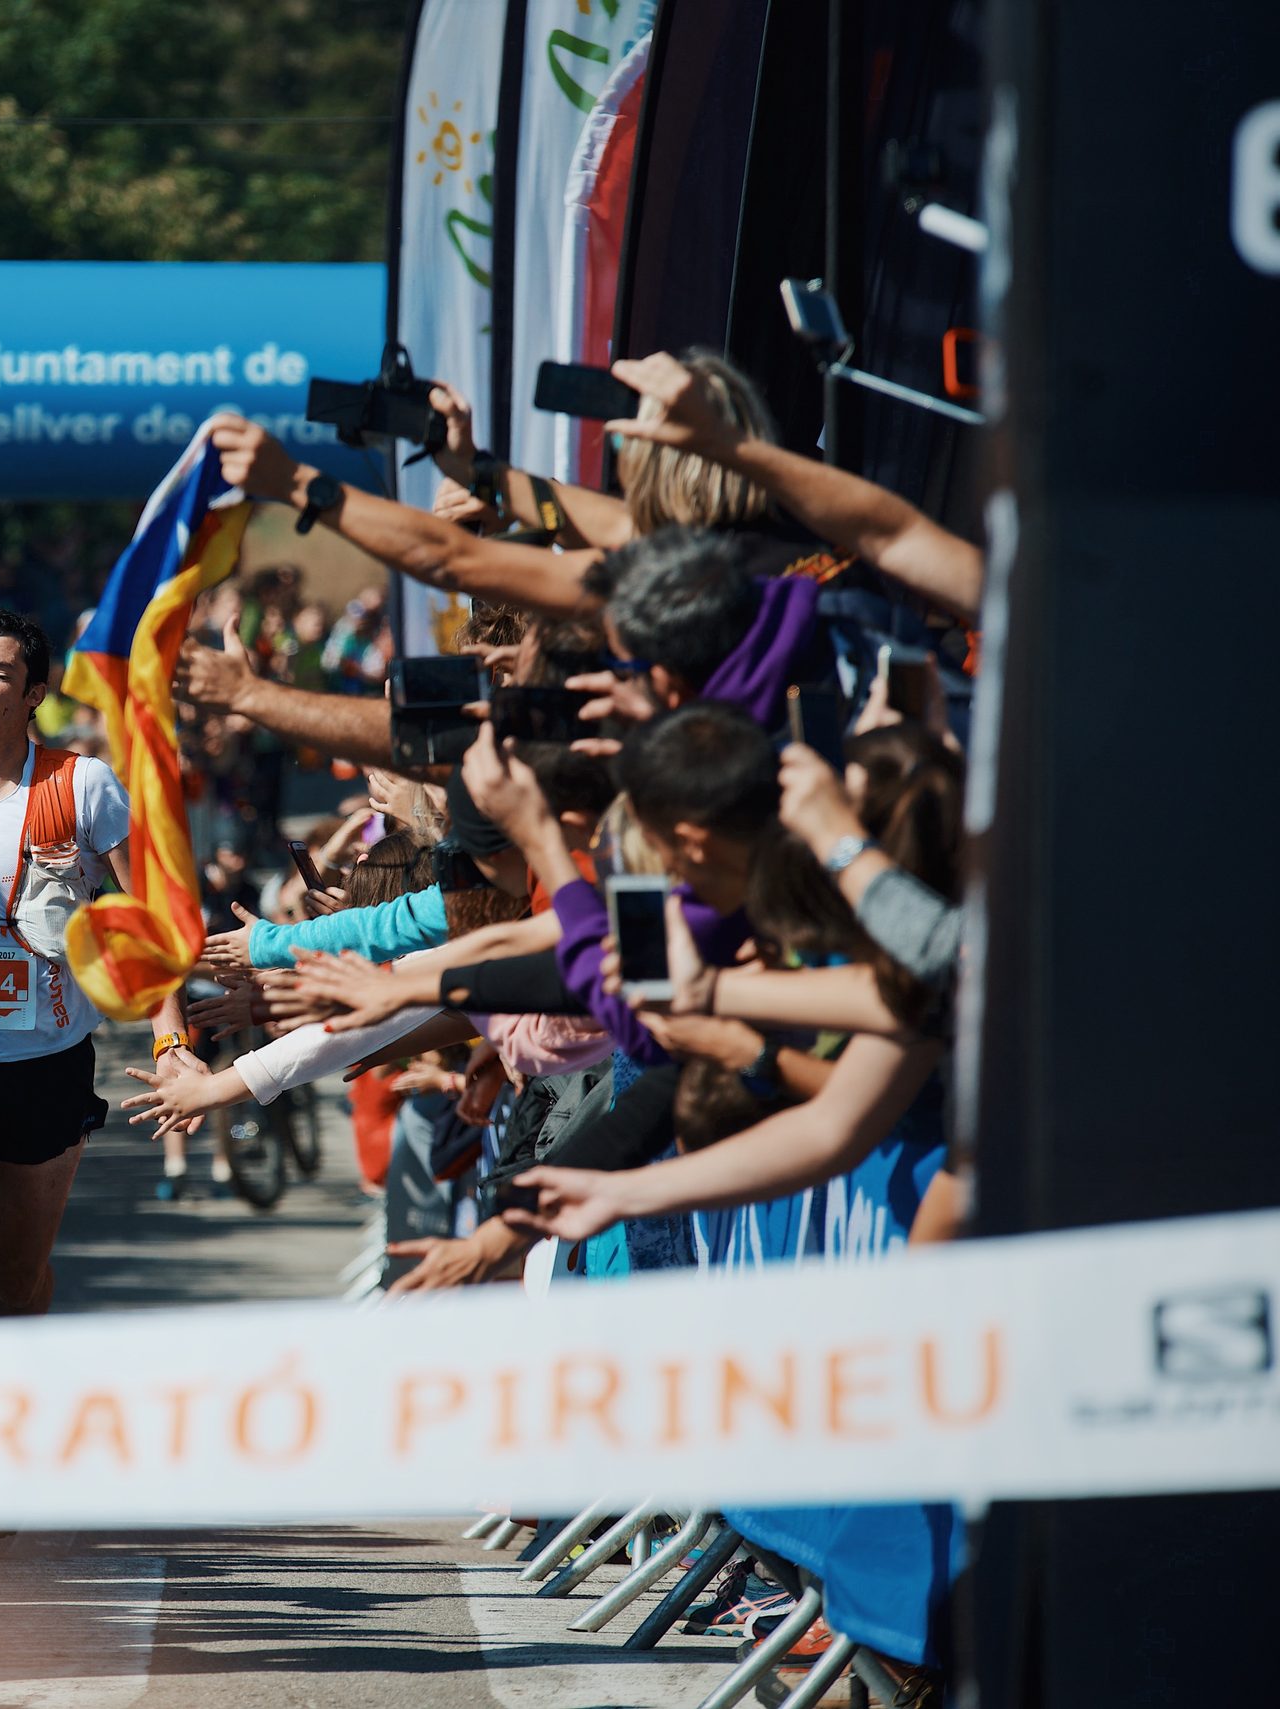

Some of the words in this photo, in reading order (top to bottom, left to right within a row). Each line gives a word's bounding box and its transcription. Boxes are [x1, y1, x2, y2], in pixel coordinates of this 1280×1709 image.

[243, 341, 308, 387] de
[132, 402, 194, 445] de
[0, 952, 16, 960] 2017
[392, 1325, 1005, 1458] PIRINEU
